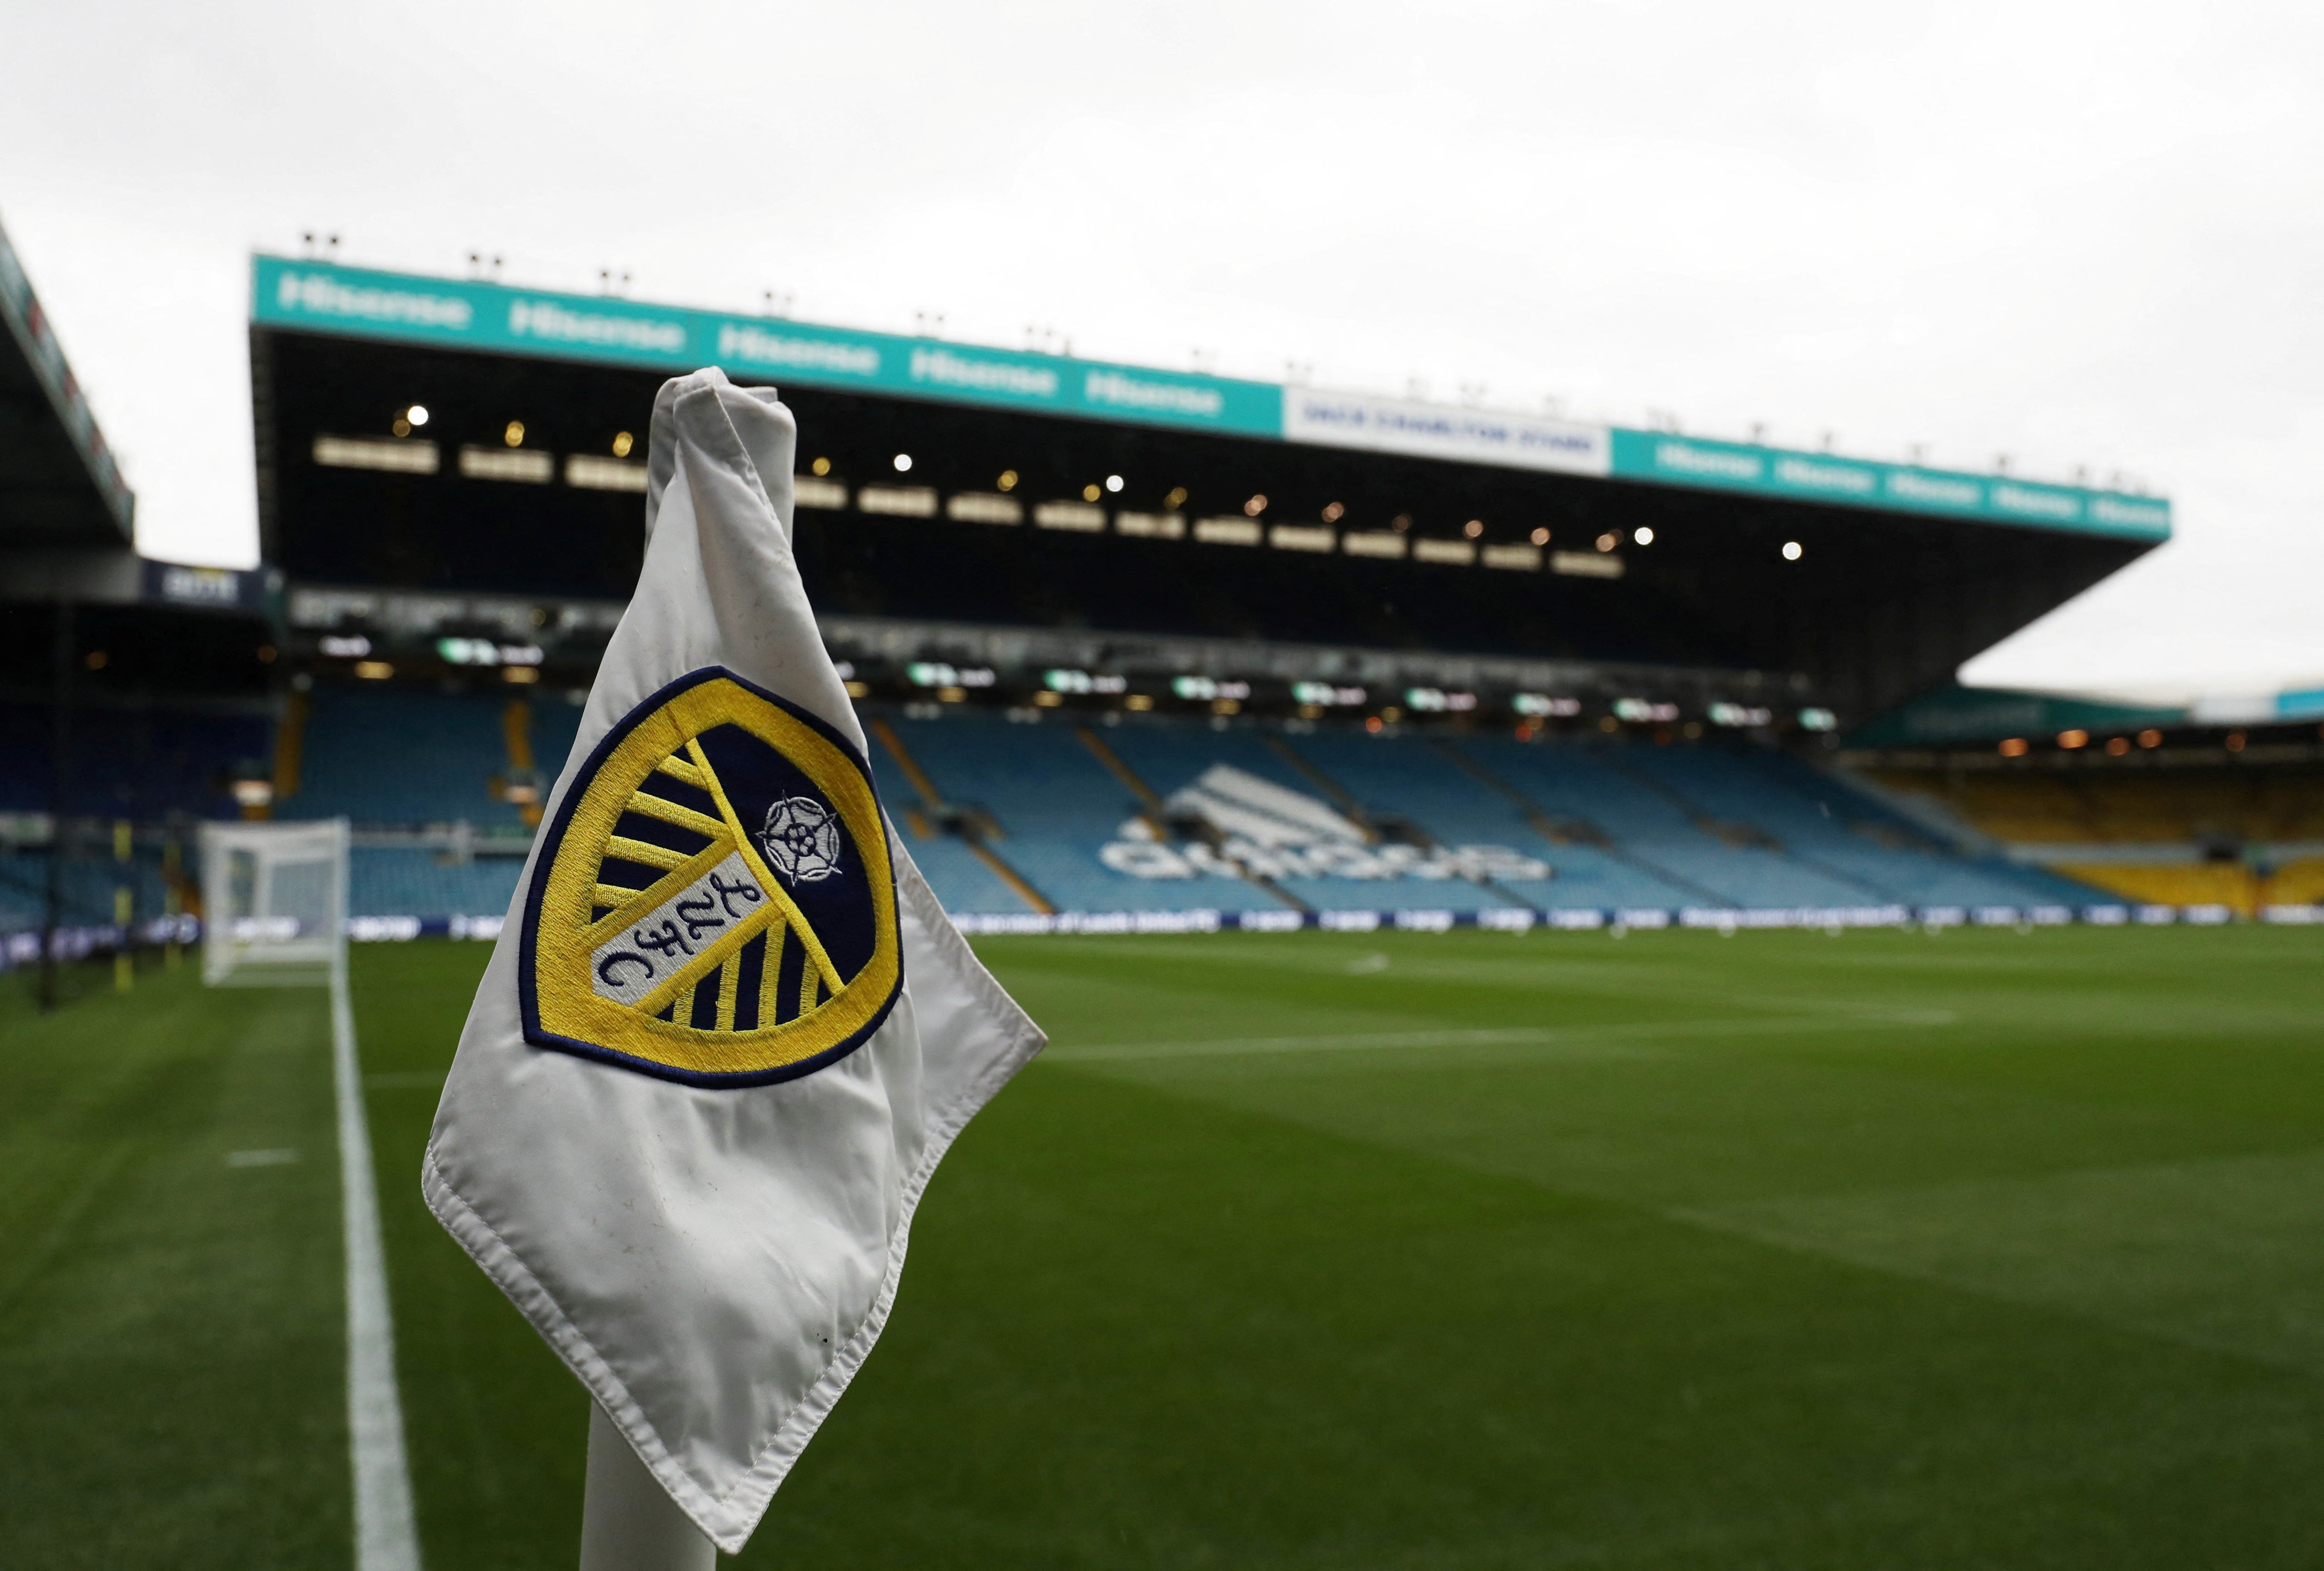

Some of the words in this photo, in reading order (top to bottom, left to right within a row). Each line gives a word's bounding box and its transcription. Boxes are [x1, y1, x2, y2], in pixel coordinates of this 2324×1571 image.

[278, 273, 472, 329] Hisense
[508, 300, 686, 353] Hisense
[718, 324, 880, 376] Hisense
[910, 347, 1058, 397] Hisense
[1085, 370, 1223, 416] Hisense
